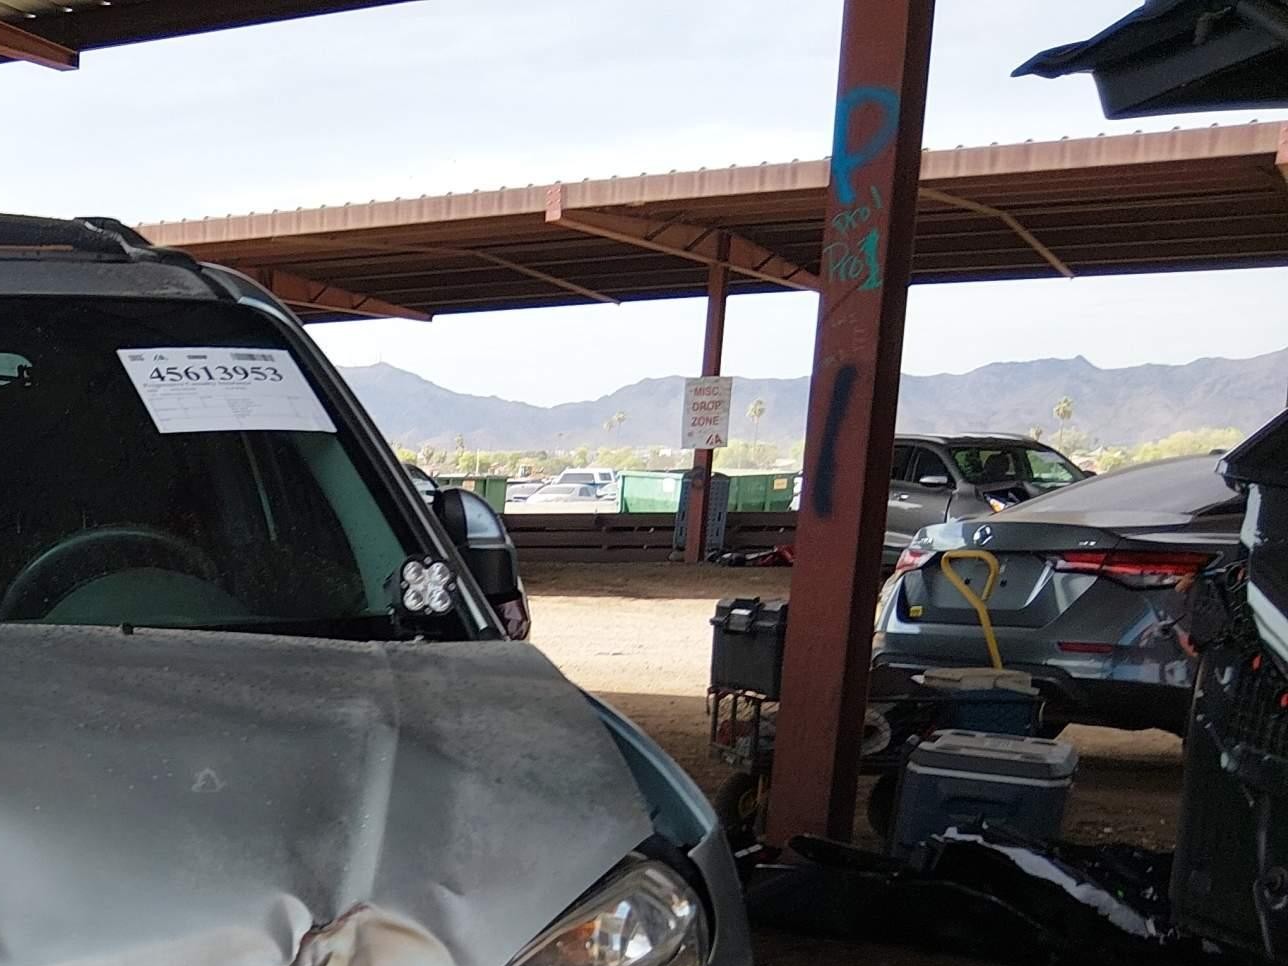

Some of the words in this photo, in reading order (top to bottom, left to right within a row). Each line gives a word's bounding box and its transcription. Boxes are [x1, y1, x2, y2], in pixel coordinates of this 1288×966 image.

[149, 364, 284, 382] 45613953
[692, 400, 721, 412] DROP
[691, 415, 720, 427] ZONE
